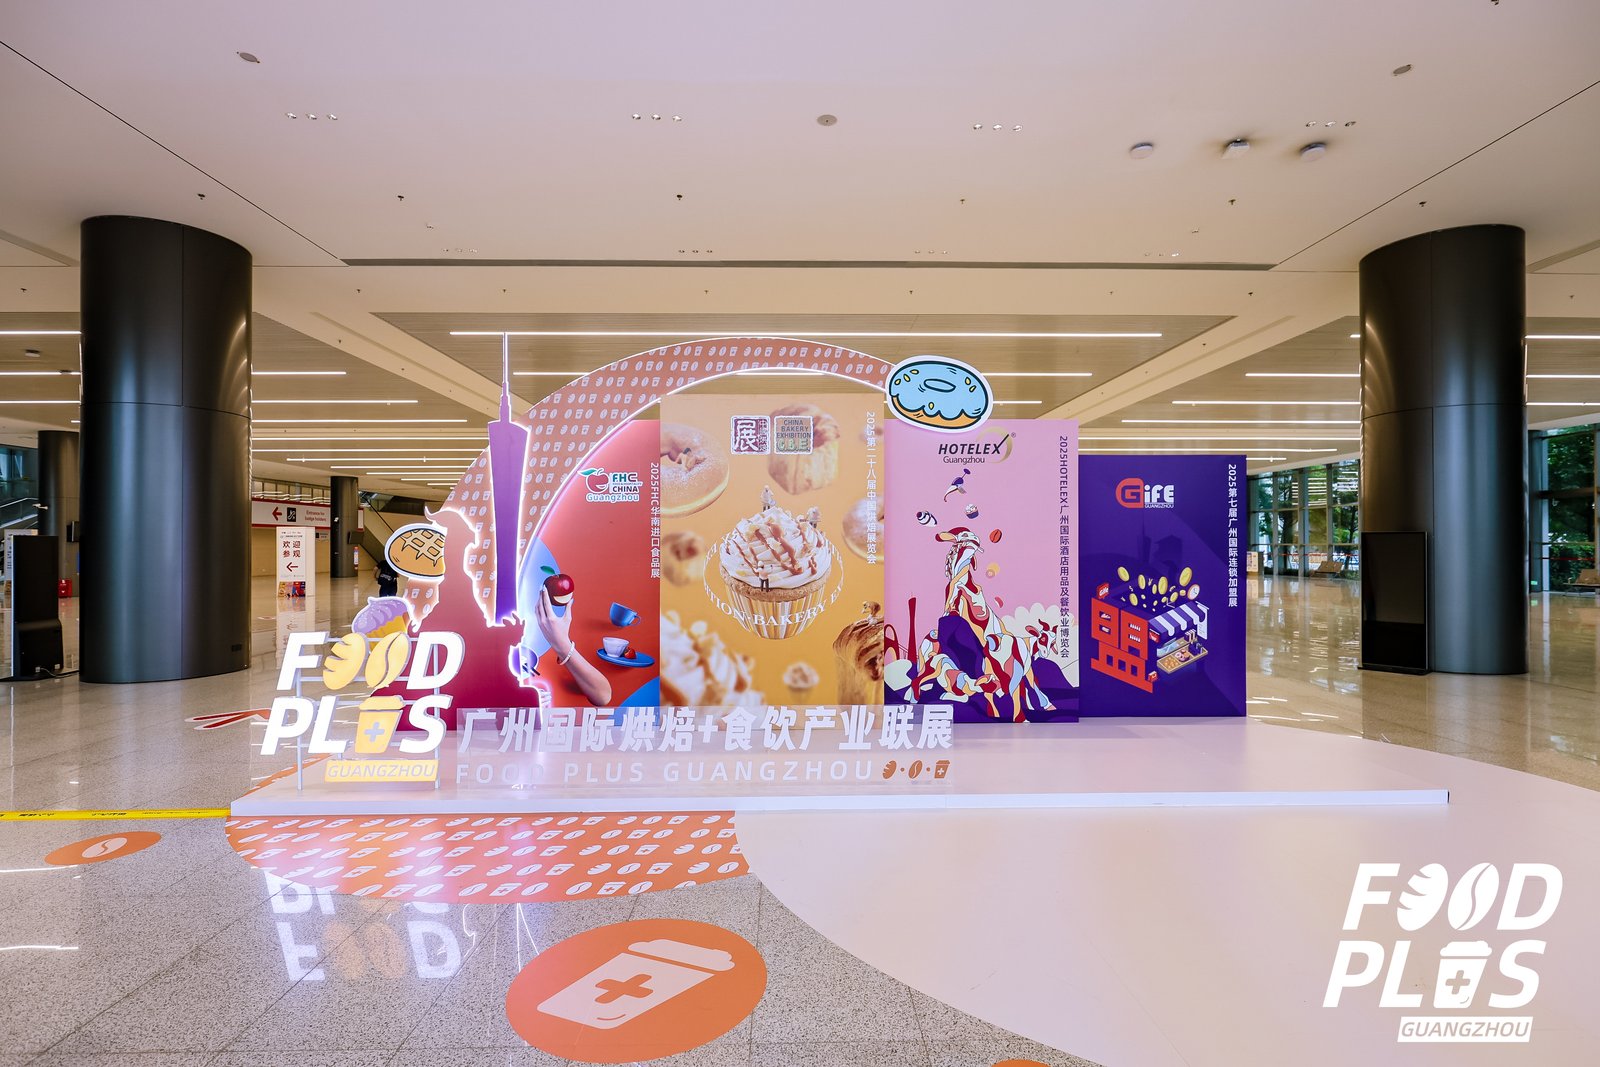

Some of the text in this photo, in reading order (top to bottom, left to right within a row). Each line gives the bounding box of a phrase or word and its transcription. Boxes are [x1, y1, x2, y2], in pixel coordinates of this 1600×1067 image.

[734, 420, 758, 451] 展
[938, 433, 1009, 455] HOTELEX
[943, 456, 985, 465] Guangzhou
[612, 473, 638, 482] FHC
[587, 494, 638, 502] Guangzhou
[651, 462, 660, 578] 2025FHC华南进口食品展
[1228, 464, 1238, 607] 2025第七届广州国际连锁加盟展
[458, 705, 954, 752] 广州国际烘焙+食饮产业联展
[327, 764, 435, 777] GUANGZHOU
[456, 760, 873, 784] FOOD PLUS GUANGZHOU
